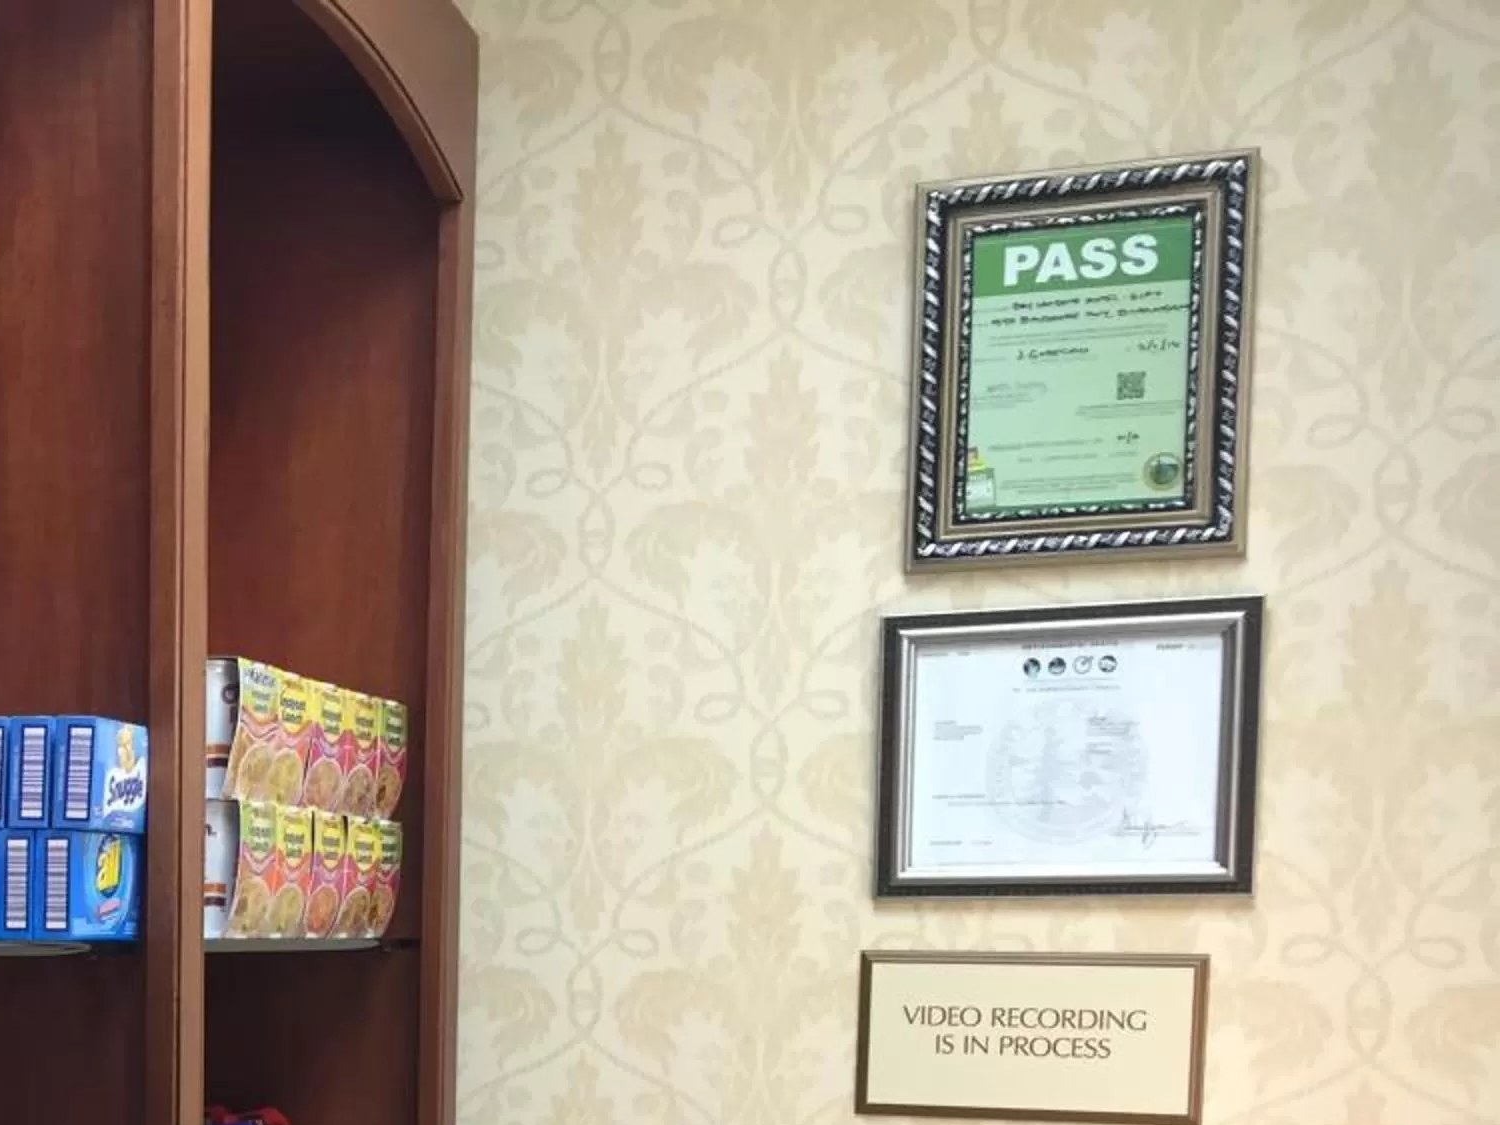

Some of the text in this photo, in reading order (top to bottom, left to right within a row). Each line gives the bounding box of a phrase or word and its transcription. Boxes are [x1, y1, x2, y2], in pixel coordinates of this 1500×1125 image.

[1003, 233, 1159, 287] PASS
[902, 1005, 1148, 1031] VIDEO RECORDING
[934, 1034, 1112, 1059] IS IN PROCESS
